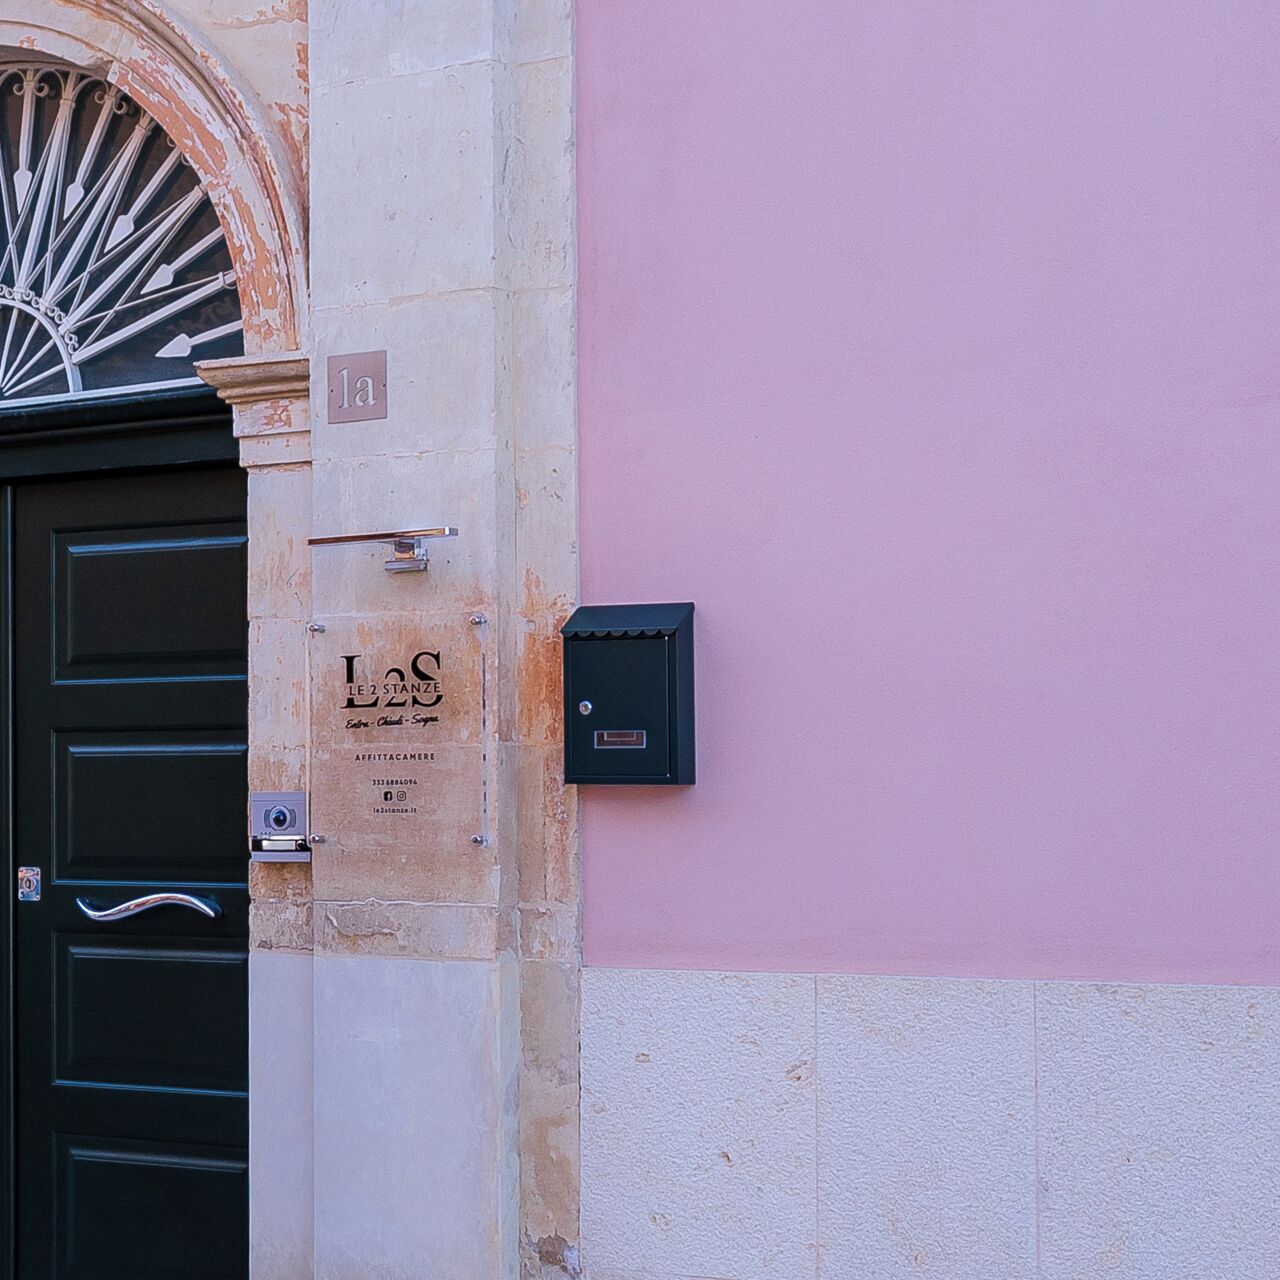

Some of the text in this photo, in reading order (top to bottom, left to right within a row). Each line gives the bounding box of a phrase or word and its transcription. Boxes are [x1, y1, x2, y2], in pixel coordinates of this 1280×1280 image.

[349, 682, 440, 696] LE 2 STANZE
[411, 713, 439, 727] Sogna
[355, 753, 435, 761] AFFITTACAMERE
